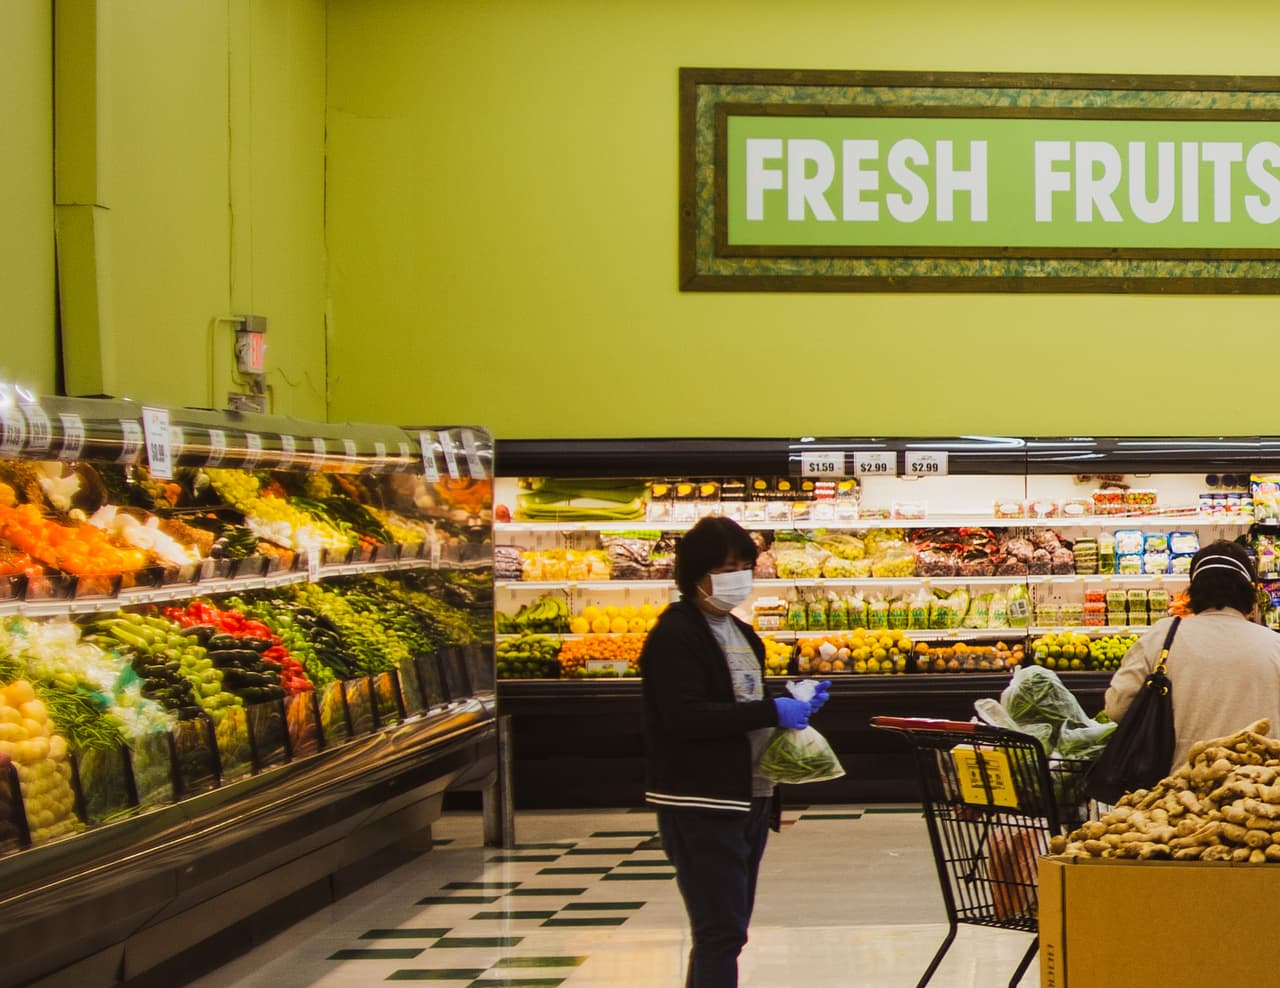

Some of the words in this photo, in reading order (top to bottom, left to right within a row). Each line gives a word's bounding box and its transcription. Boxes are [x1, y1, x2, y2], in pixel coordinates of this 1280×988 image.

[745, 138, 988, 224] FRESH
[809, 462, 835, 473] $1.59
[860, 462, 887, 473] $2.99
[911, 462, 939, 473] $2.99
